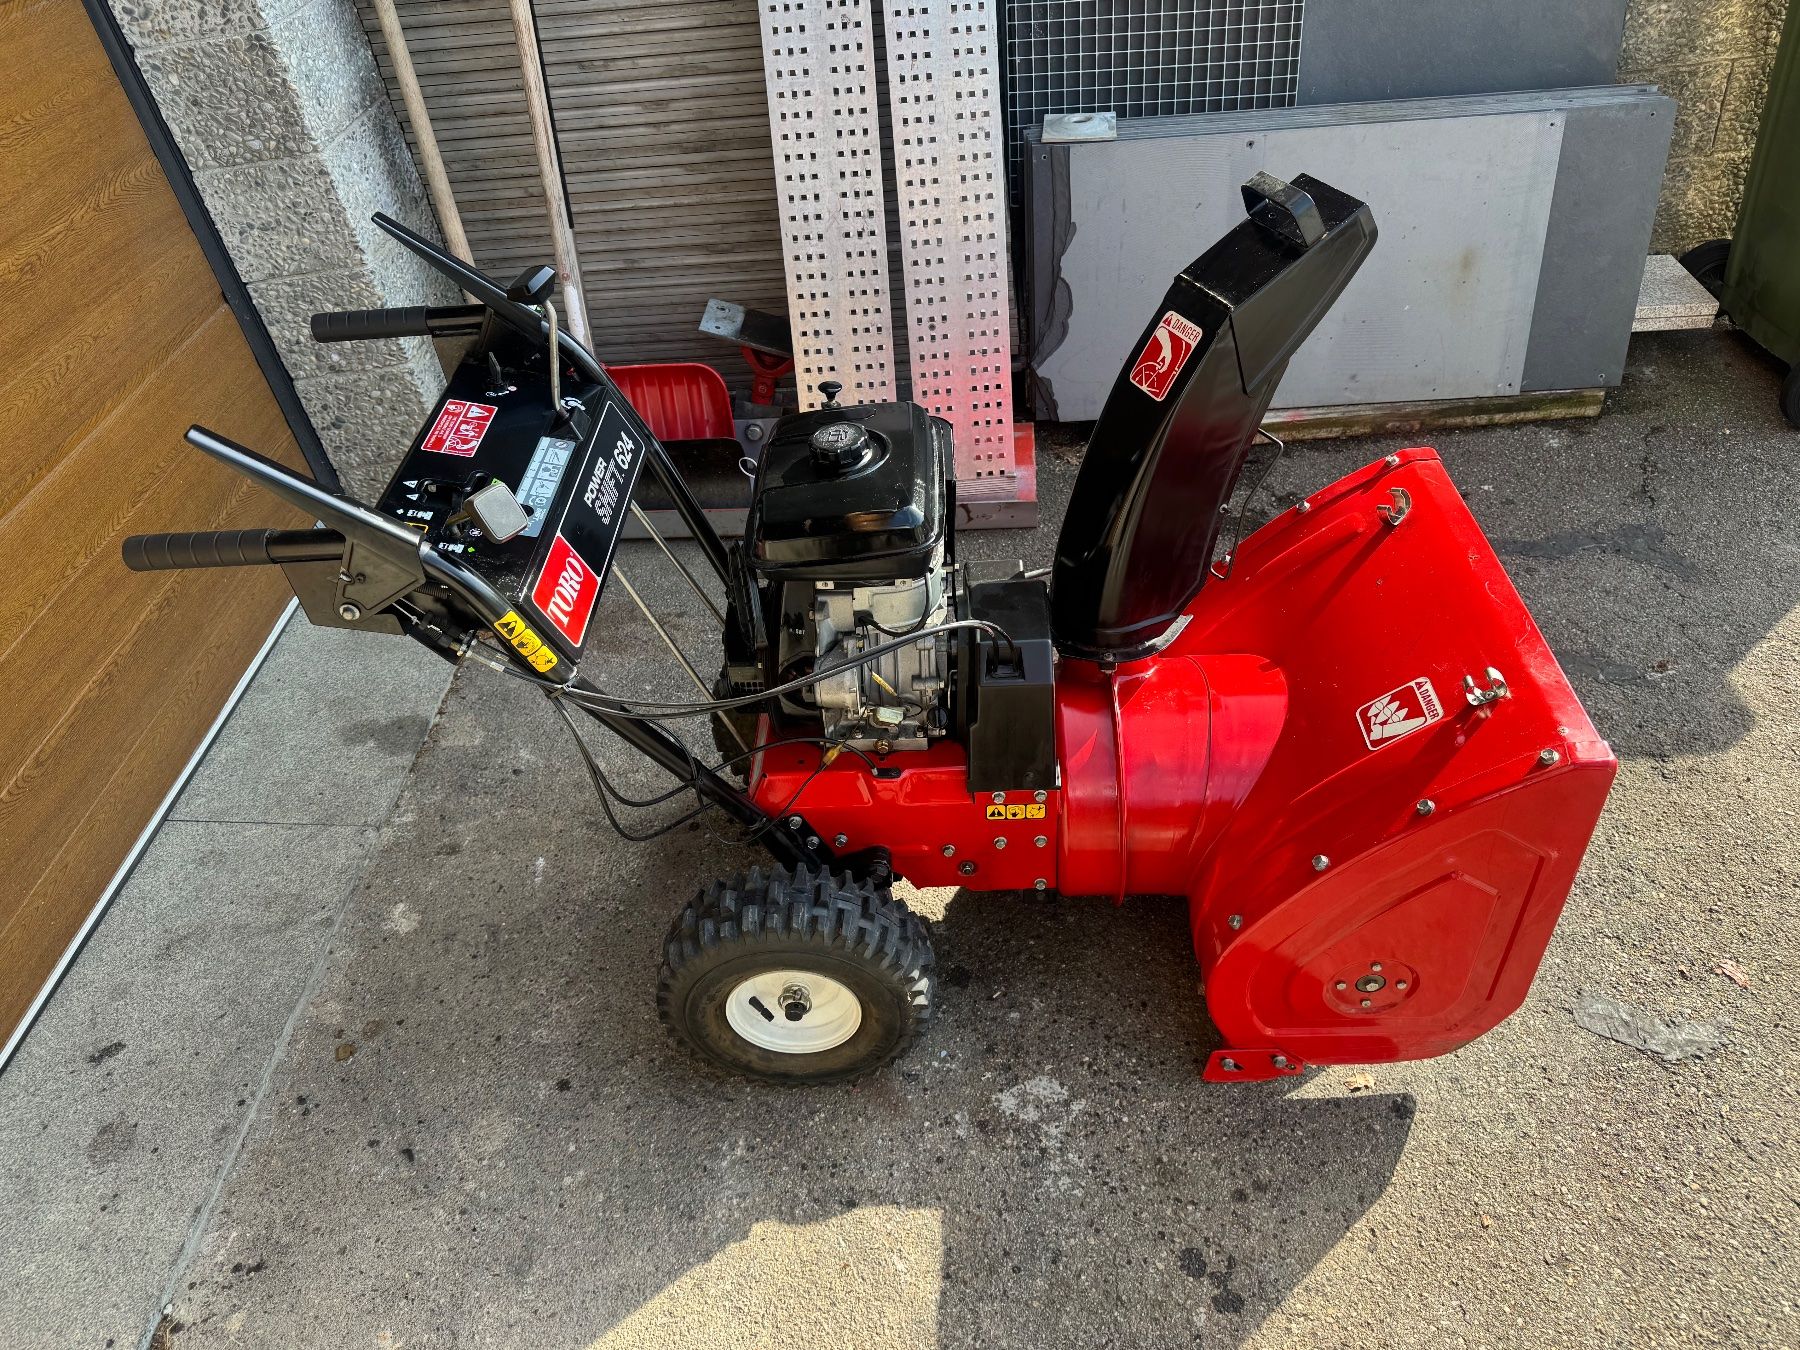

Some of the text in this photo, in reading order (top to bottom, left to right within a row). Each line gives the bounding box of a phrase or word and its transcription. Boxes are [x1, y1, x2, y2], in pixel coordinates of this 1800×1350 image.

[1171, 318, 1201, 343] DANGER
[583, 456, 608, 508] POWER
[594, 430, 635, 526] SHIFT 624
[547, 556, 584, 628] TORO
[1418, 688, 1440, 721] DANGER
